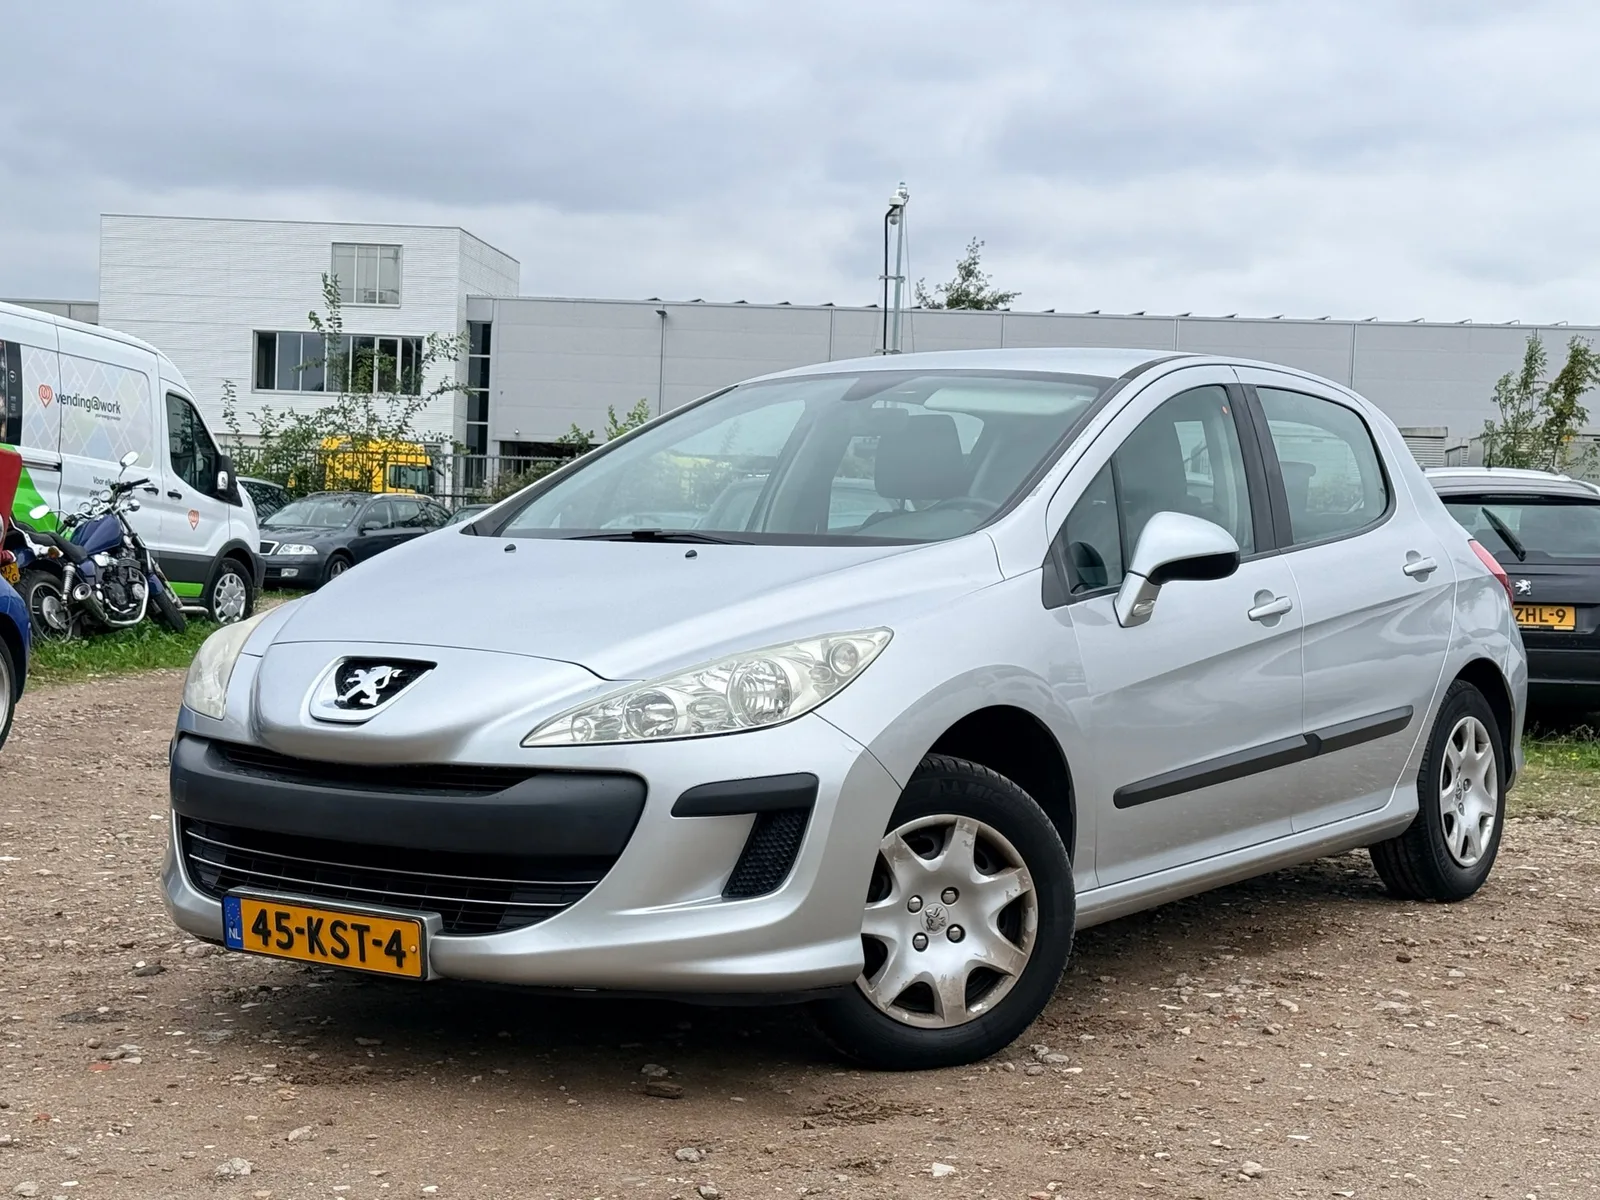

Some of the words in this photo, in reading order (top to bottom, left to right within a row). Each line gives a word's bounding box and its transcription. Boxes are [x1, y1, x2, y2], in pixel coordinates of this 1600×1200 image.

[54, 392, 121, 415] vending@work
[1514, 607, 1567, 624] ZHL-9
[228, 927, 242, 940] NL
[251, 908, 407, 969] 45-KST-4
